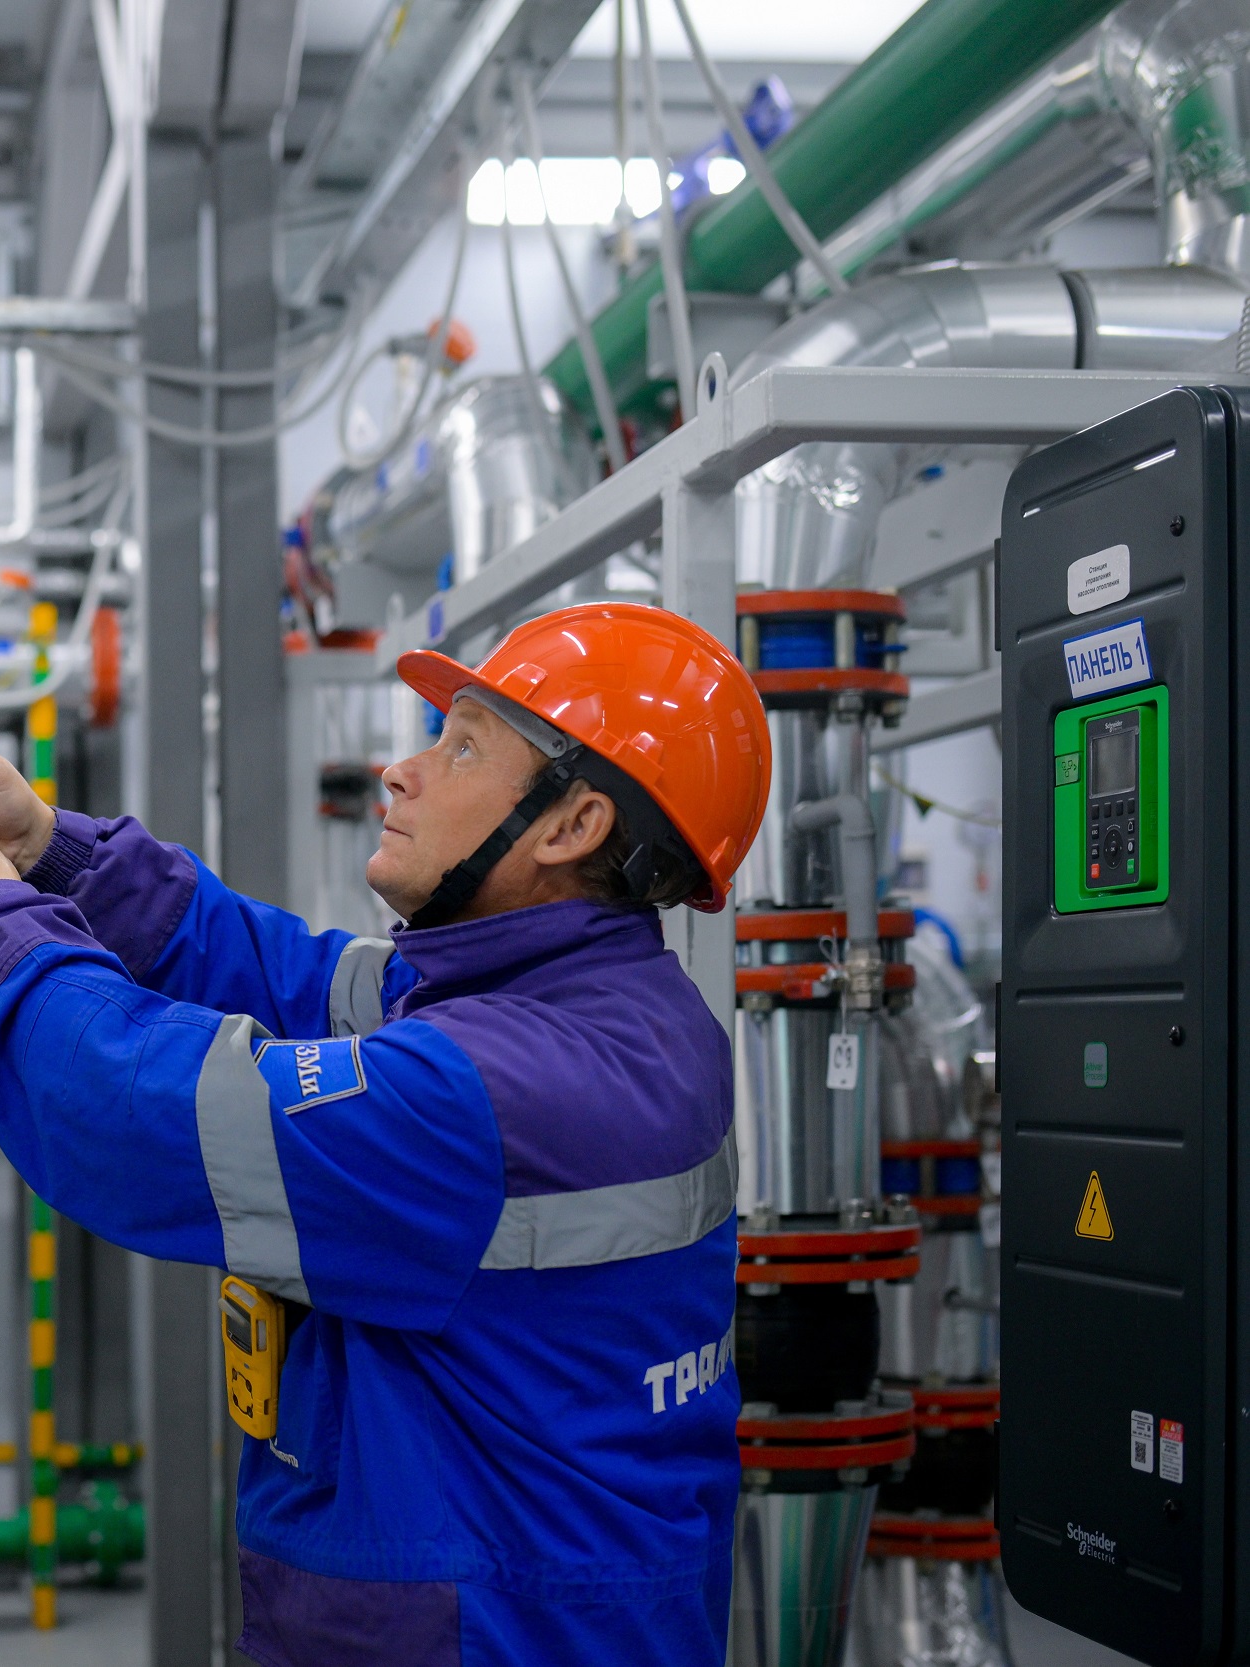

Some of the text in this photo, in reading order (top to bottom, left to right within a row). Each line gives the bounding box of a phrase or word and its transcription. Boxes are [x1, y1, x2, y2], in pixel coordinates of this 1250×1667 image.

[1088, 562, 1108, 574] Станция
[1077, 578, 1120, 598] насосом отопления
[1085, 571, 1112, 587] управления
[1067, 636, 1146, 685] ПАНЕЛЬ 1
[1066, 1521, 1117, 1553] Schneider
[1086, 1545, 1116, 1565] Electric
